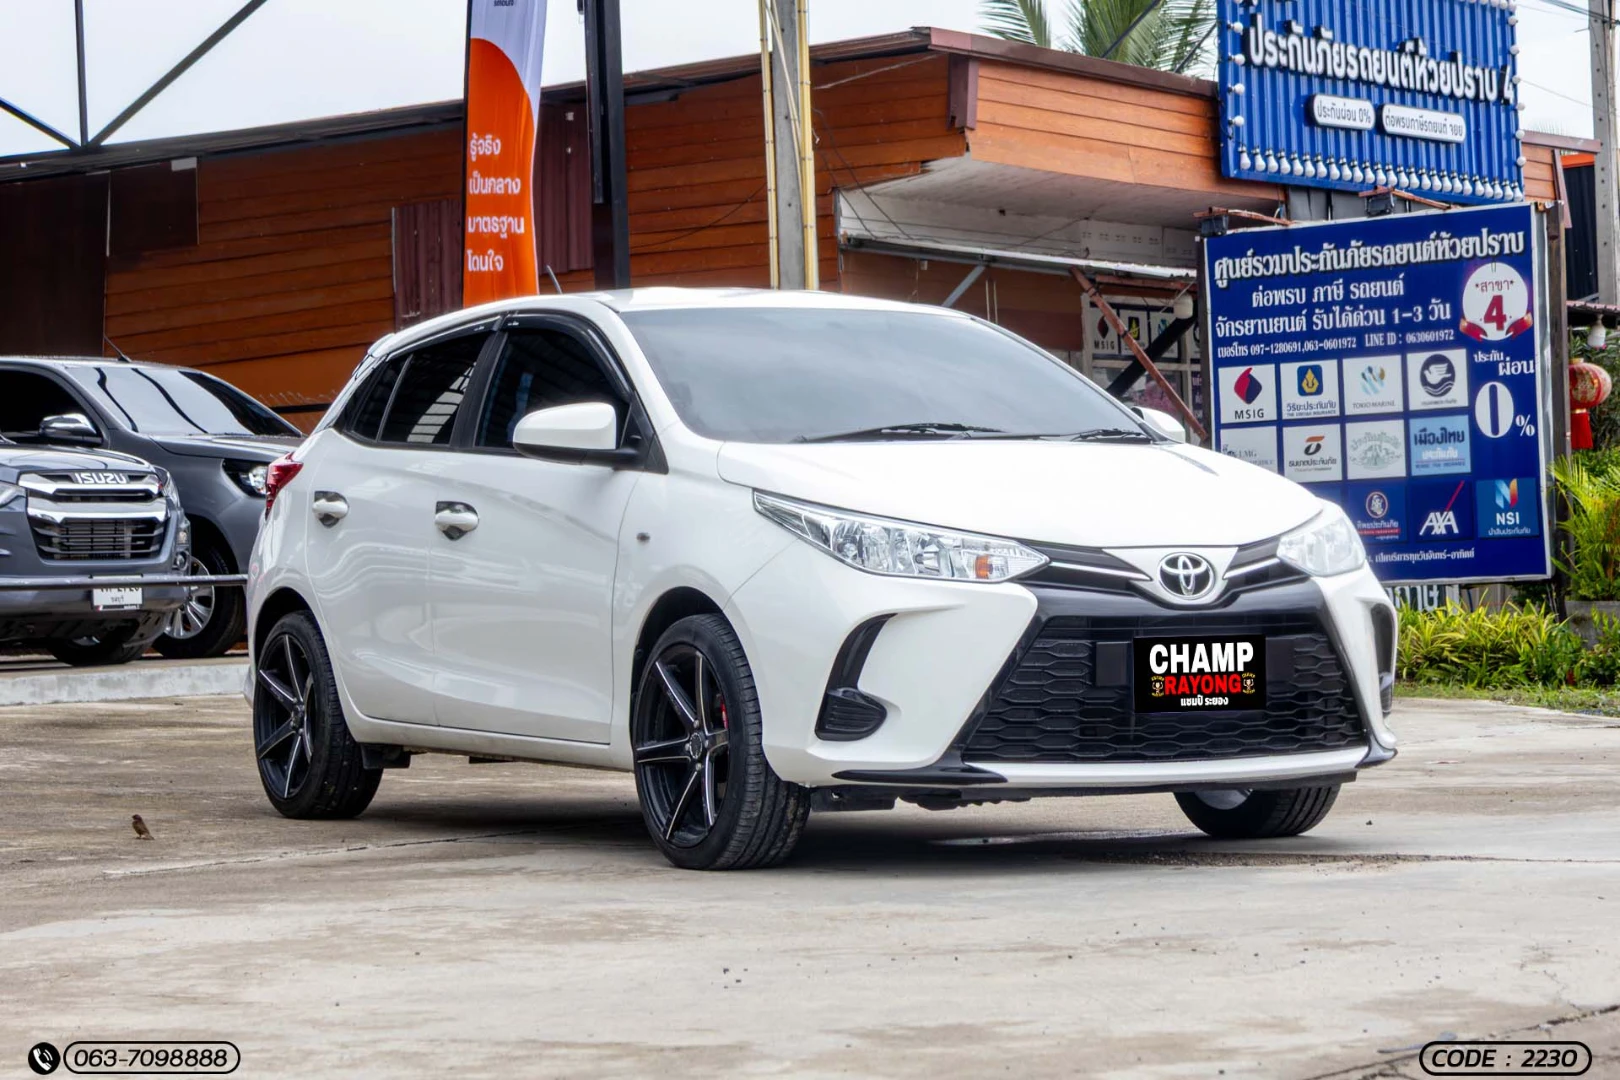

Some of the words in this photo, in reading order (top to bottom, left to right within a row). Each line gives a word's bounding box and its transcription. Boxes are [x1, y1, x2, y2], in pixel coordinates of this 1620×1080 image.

[1249, 13, 1498, 103] ประกันภัยรถยนต์ห้วยปราบ
[1503, 65, 1515, 104] 4
[1317, 102, 1357, 122] ประกันผ่อน
[1358, 107, 1371, 124] 0%
[470, 132, 502, 162] รู้จริง
[469, 170, 521, 195] เป็นกลาง
[467, 216, 525, 239] มาตรฐาน
[466, 248, 504, 272] โดนใจ
[1214, 228, 1525, 288] ศูนย์รวมประกันภัยรถยนต์ห้วยปราบ
[1252, 285, 1307, 308] ต่อพรบ
[1312, 278, 1344, 303] ภาษี
[1349, 272, 1405, 300] รถยนต์
[1215, 308, 1308, 338] จักรยานยนต์
[1312, 303, 1386, 331] รับได้ด่วน
[1392, 305, 1423, 325] 1-3
[1428, 297, 1452, 321] วัน
[1483, 294, 1507, 331] 4
[1094, 340, 1115, 350] MSIG
[1365, 332, 1385, 347] LINE
[1387, 332, 1397, 346] ID
[1473, 350, 1504, 363] ประกัน
[1499, 356, 1535, 376] ผ่อน
[1235, 408, 1265, 420] MSIG
[1414, 427, 1465, 446] เมืองไทย
[74, 472, 128, 484] ISUZU
[1419, 510, 1460, 536] AXA
[1496, 512, 1520, 526] NSI
